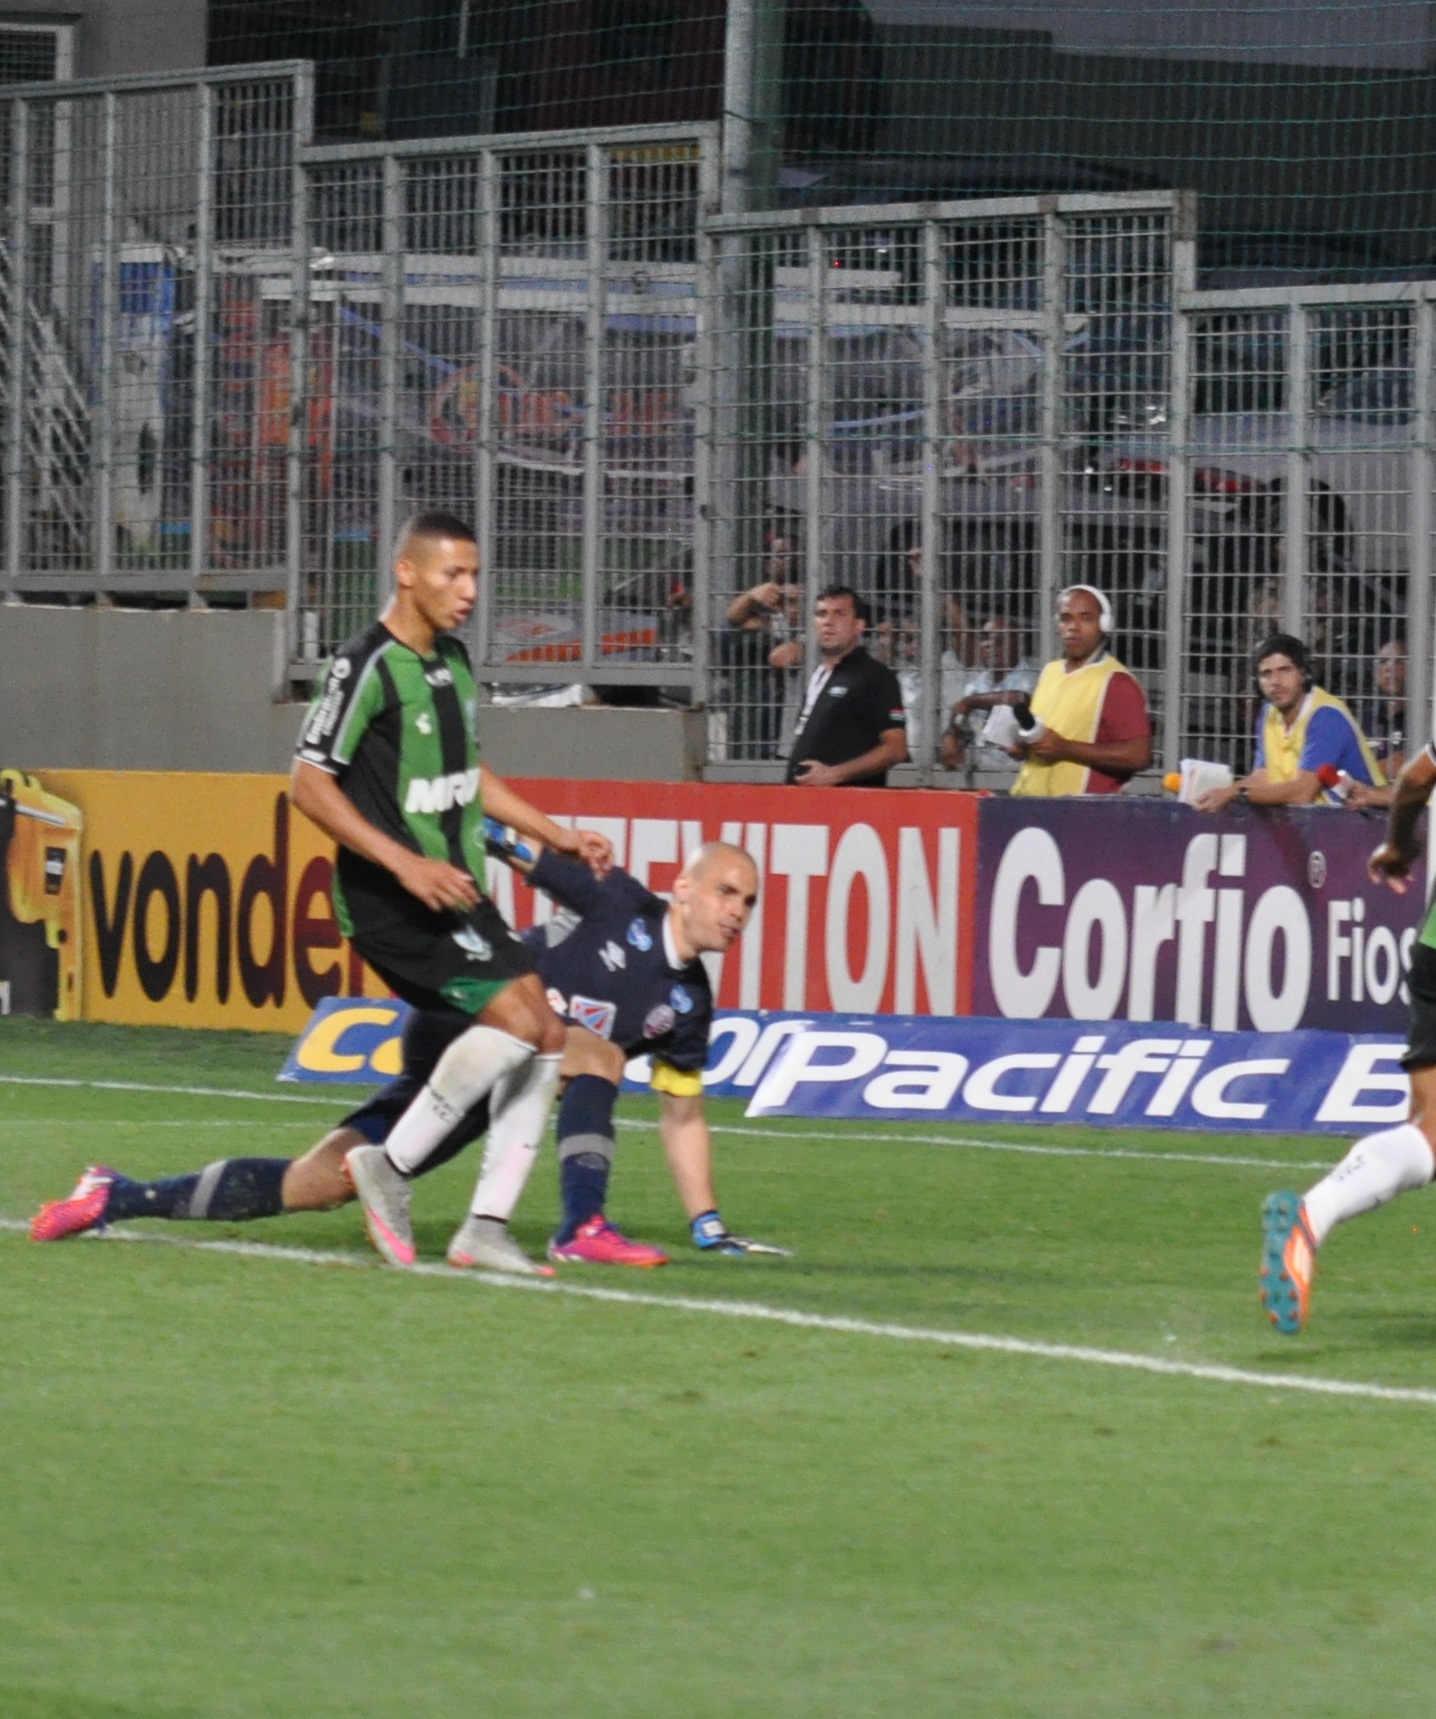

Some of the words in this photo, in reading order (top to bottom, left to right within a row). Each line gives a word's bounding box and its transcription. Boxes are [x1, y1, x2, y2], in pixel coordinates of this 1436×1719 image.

[90, 791, 364, 1009] vonde
[989, 827, 1312, 1032] Corfio
[750, 1031, 1291, 1119] Pacific
